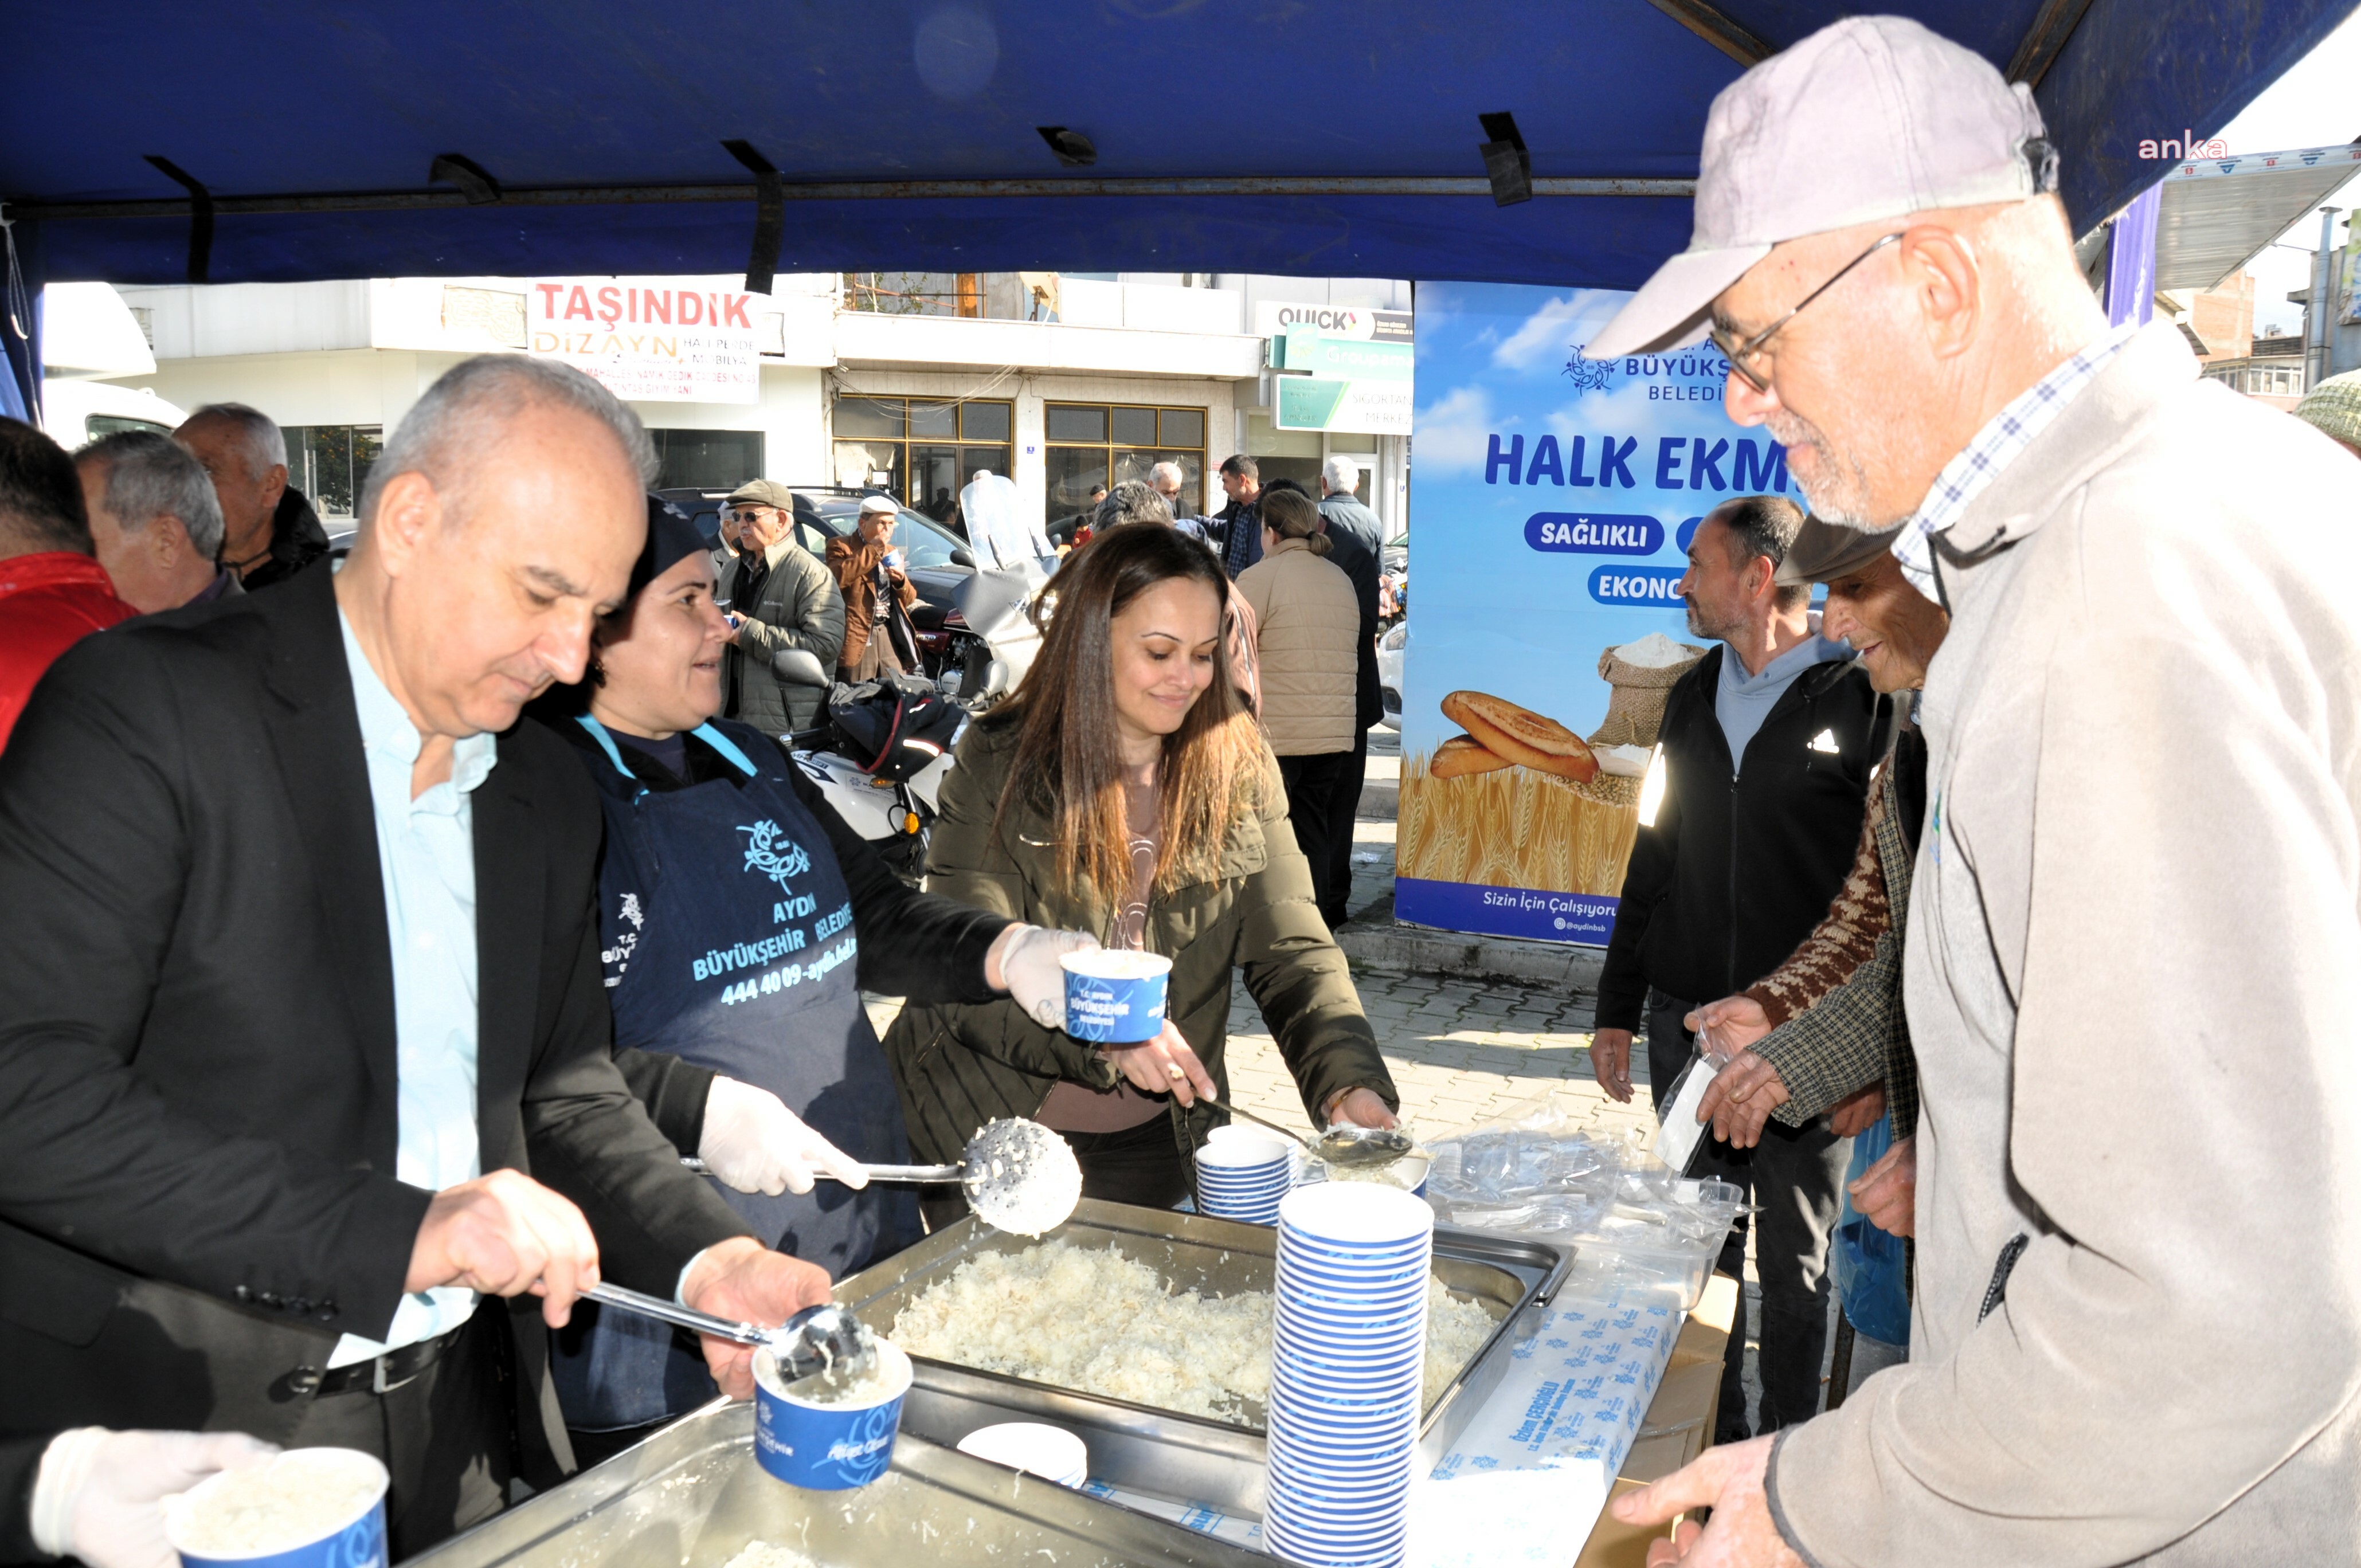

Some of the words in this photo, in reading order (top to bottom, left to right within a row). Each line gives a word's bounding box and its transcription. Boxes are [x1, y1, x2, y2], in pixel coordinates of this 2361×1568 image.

[535, 283, 753, 332] TAŞINDIK
[1278, 308, 1347, 331] QUICK
[1366, 412, 1412, 425] MERKEZ
[1485, 434, 1638, 489] HALK
[1655, 437, 1802, 493] EKM
[1541, 518, 1647, 547] SAĞLIKLI
[1483, 892, 1517, 907] Sizin
[1520, 892, 1545, 911] İçin
[1567, 922, 1606, 932] @aydinbsb
[692, 927, 806, 981] BÜYÜKŞEHİR
[721, 978, 758, 1006] 444
[760, 971, 781, 994] 40
[781, 963, 802, 987] 09
